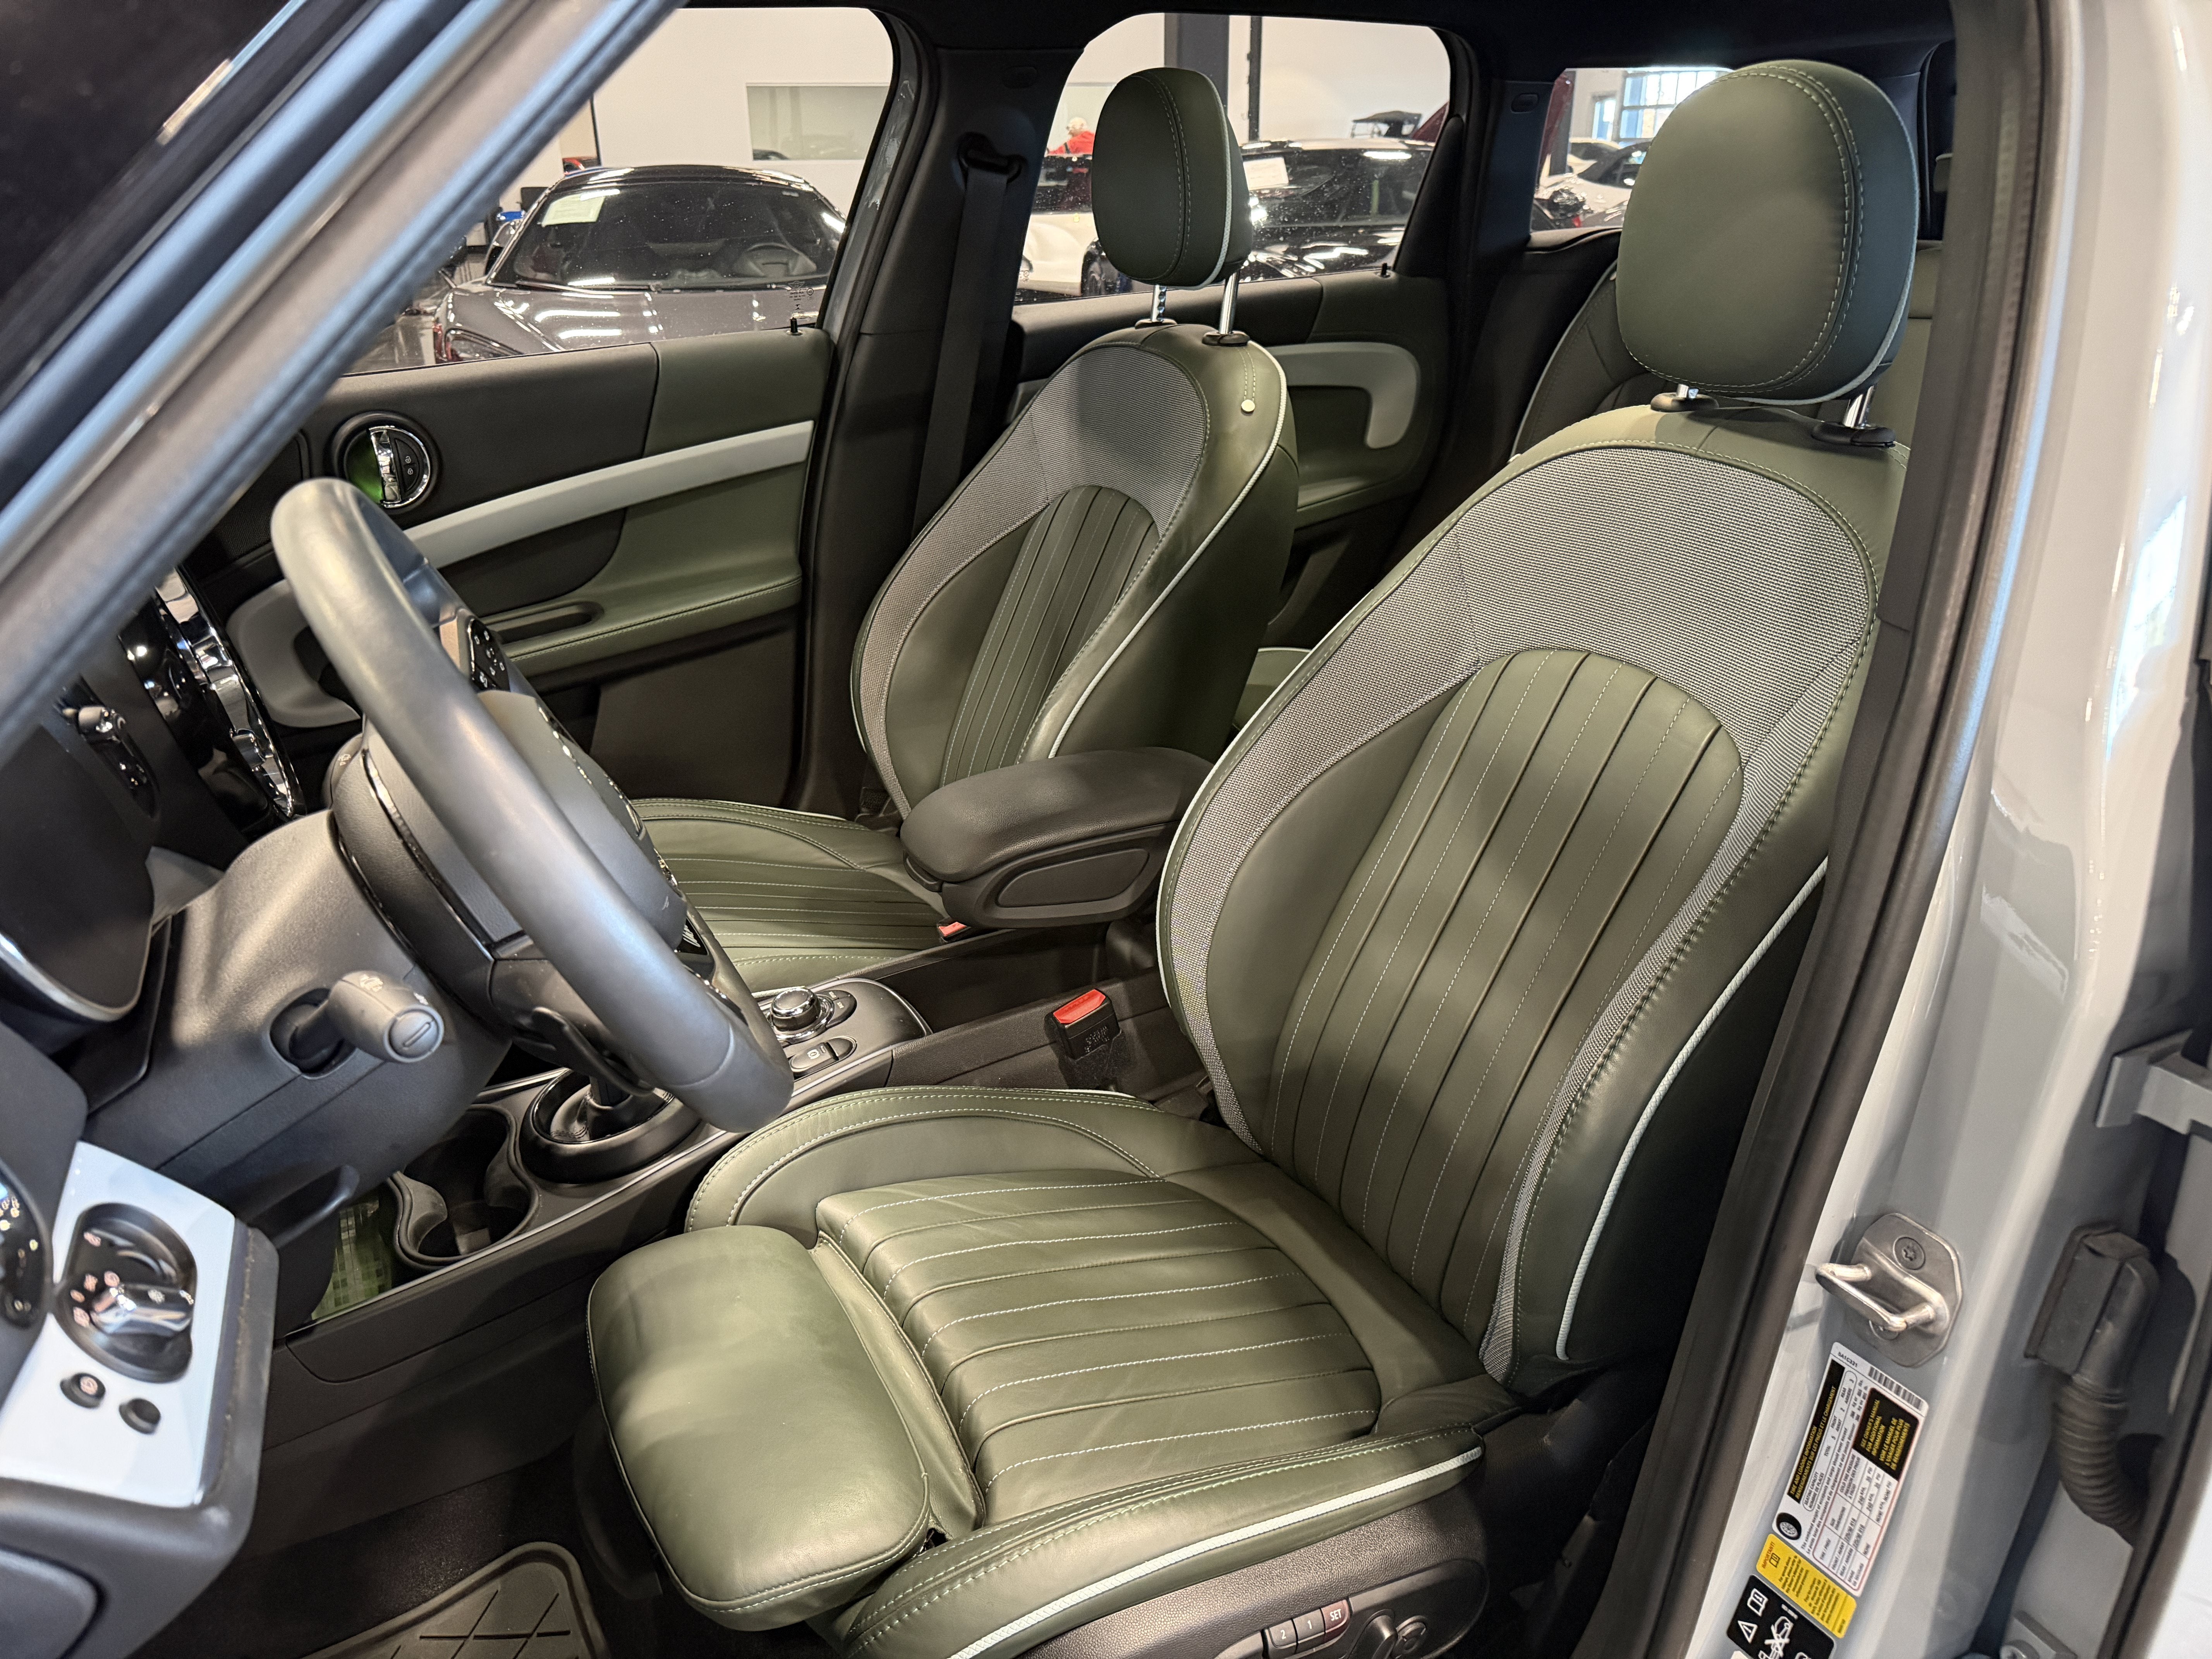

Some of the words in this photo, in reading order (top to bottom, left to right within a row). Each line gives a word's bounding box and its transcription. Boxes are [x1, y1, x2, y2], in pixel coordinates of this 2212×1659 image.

[1823, 1385, 1837, 1417] CHARGEMENT
[1819, 1420, 1825, 1429] ET
[1821, 1415, 1827, 1423] LE
[1862, 1417, 1874, 1439] OWNER'S
[1869, 1398, 1880, 1419] MANUAL
[1890, 1416, 1898, 1426] DE
[1895, 1417, 1905, 1432] PLUS
[1814, 1427, 1823, 1444] PNEUS
[1868, 1413, 1883, 1443] ADDITIONAL
[1884, 1424, 1896, 1445] MANUEL
[1870, 1423, 1886, 1457] INFORMATION
[1891, 1429, 1901, 1445] POUR
[1797, 1454, 1807, 1476] LOADING
[1803, 1424, 1817, 1456] INFORMATION
[1865, 1441, 1873, 1453] FOR
[1882, 1443, 1889, 1451] LE
[1884, 1442, 1896, 1467] L'USAGER
[1878, 1449, 1887, 1462] VOIR
[1889, 1462, 1897, 1471] DE
[1795, 1459, 1812, 1500] RENSEIGNEMENTS
[1804, 1488, 1812, 1506] SEATING
[1809, 1470, 1819, 1490] CAPACITY
[1808, 1491, 1817, 1509] NOMBRE
[1760, 1541, 1775, 1569] IMPORTANT!
[1330, 1608, 1341, 1621] SET
[1307, 1620, 1312, 1629] 1
[1280, 1630, 1286, 1640] 2
